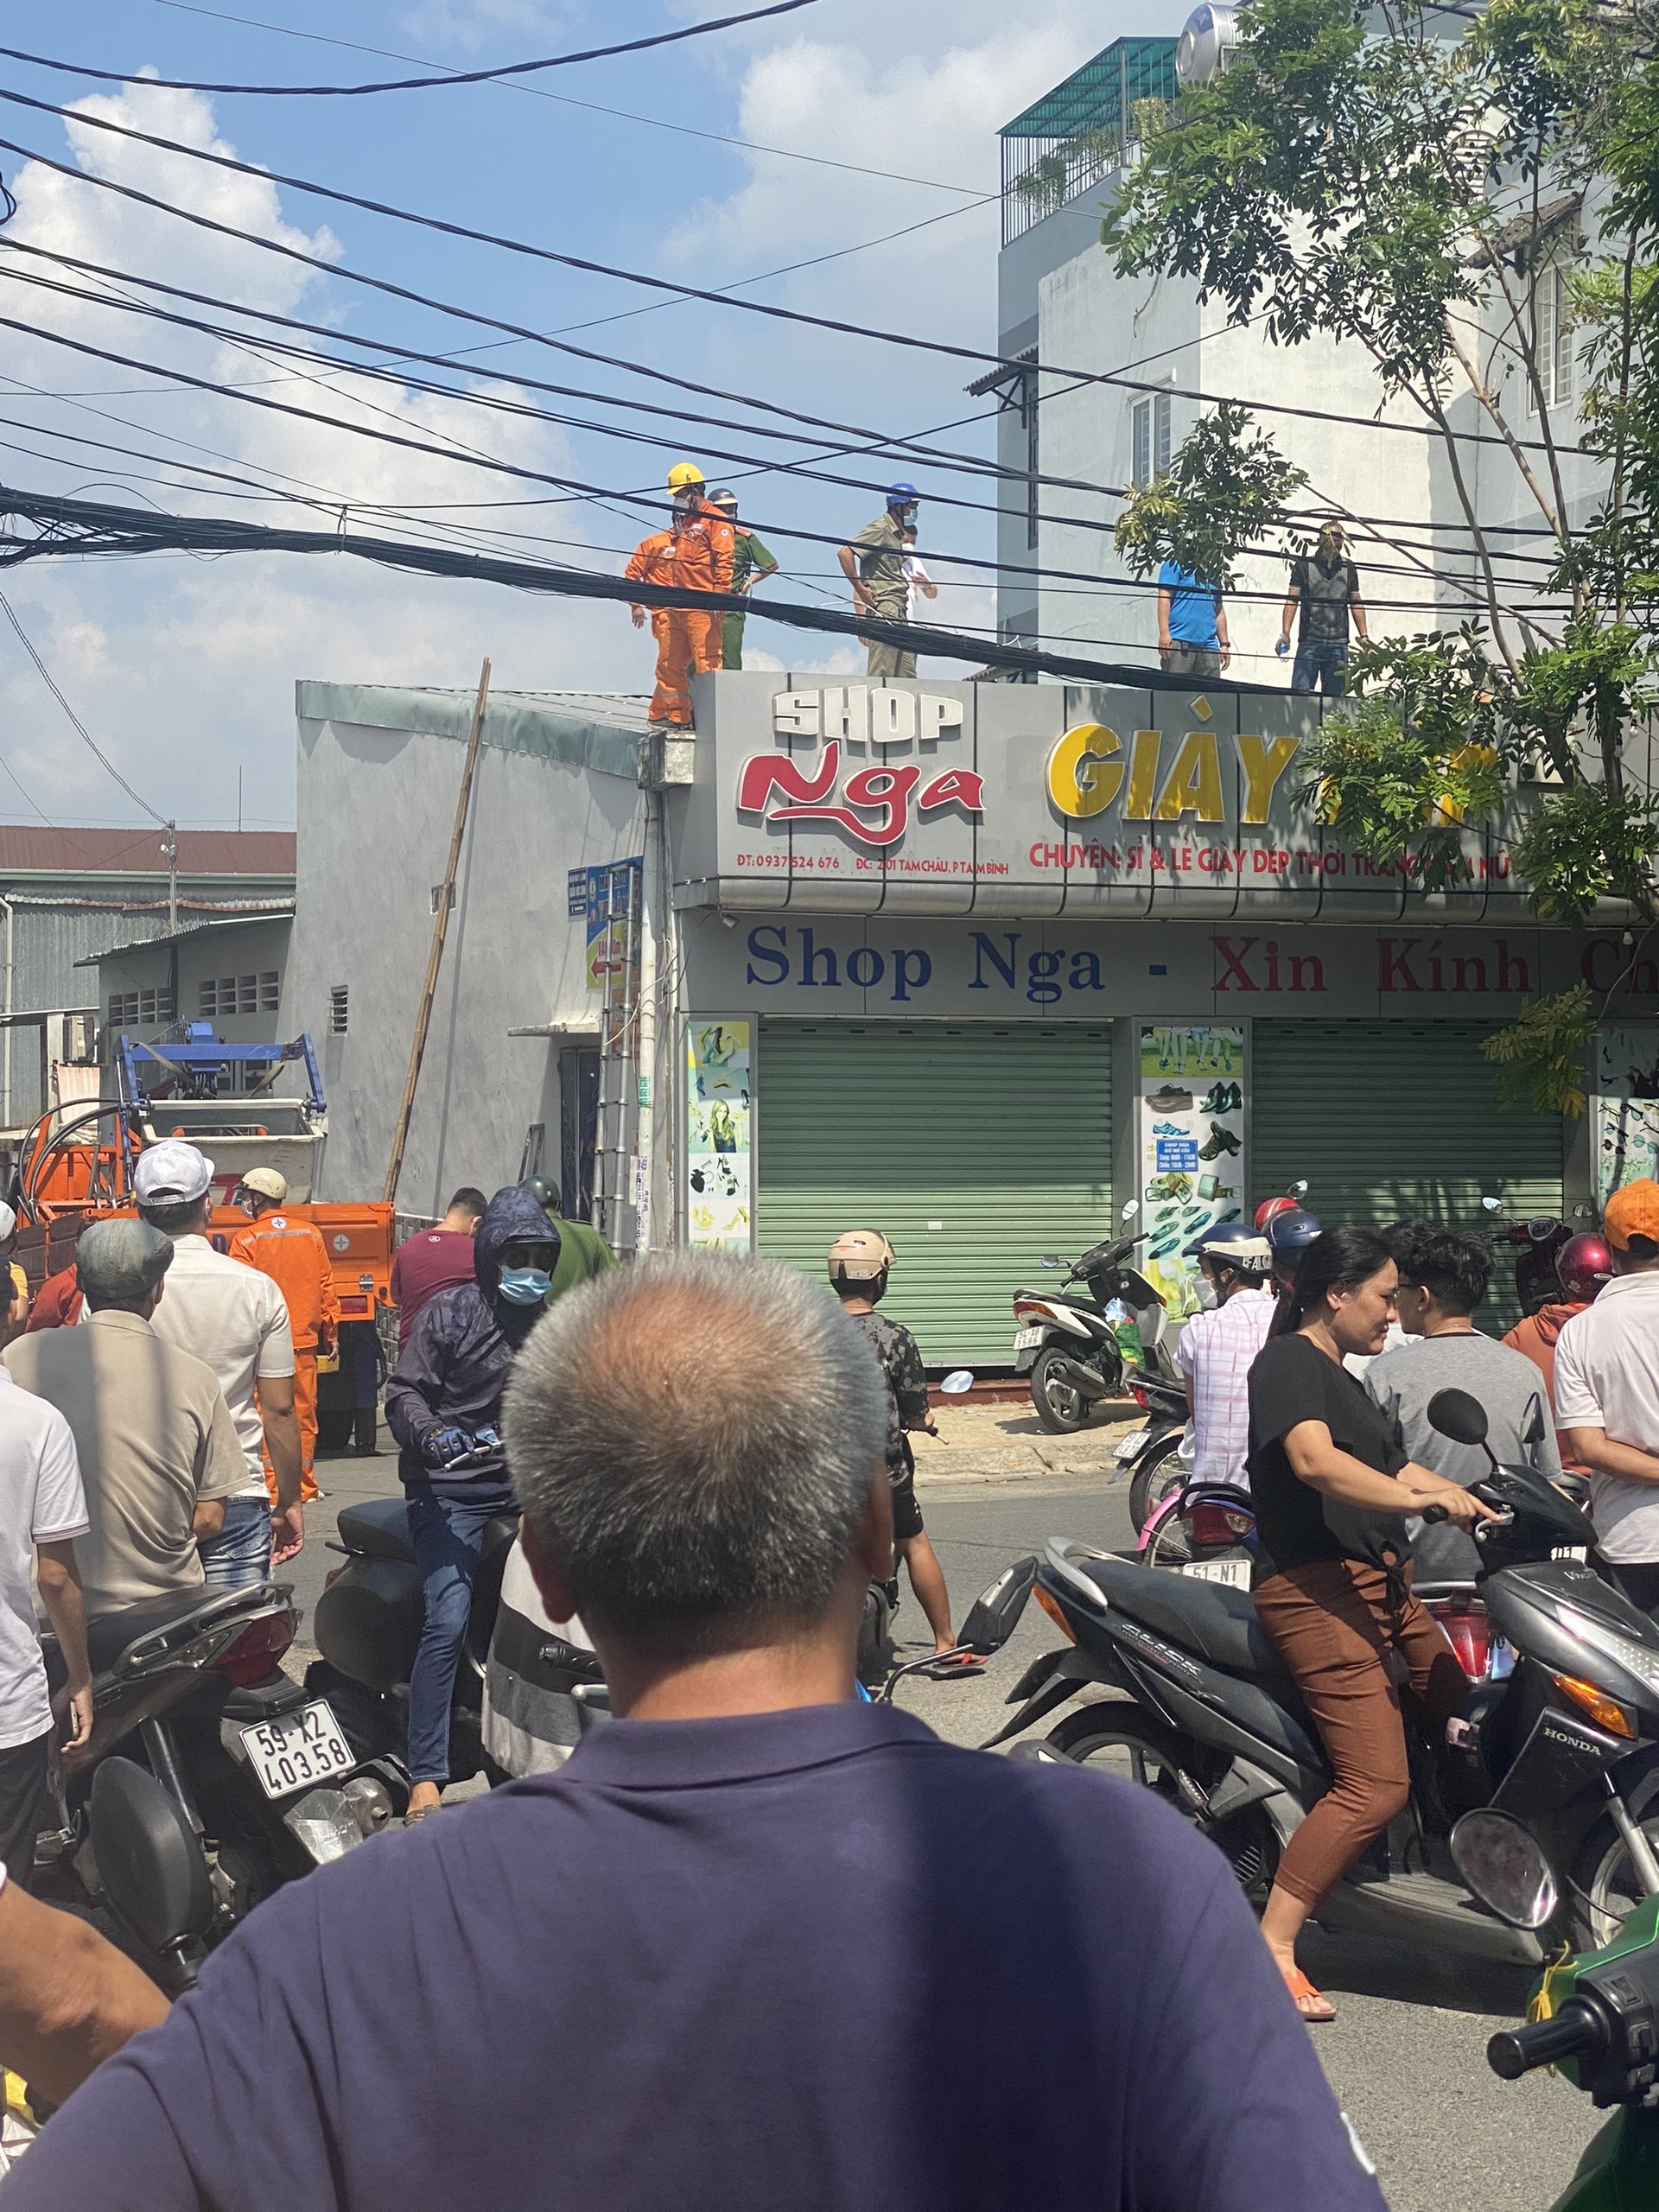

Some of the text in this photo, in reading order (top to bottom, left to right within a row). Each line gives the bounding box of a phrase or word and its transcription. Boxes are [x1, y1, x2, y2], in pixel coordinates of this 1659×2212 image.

[774, 685, 963, 742] SHOP
[1048, 695, 1302, 825] GIÀY
[738, 740, 987, 846] Nga
[818, 856, 840, 869] 676
[1029, 837, 1122, 869] CHUYÊN:
[1149, 845, 1166, 871] &
[1198, 840, 1248, 874] GIÀY
[1253, 842, 1290, 874] DÉP
[1295, 844, 1346, 876] THỜI
[747, 925, 932, 1001] Shop
[968, 932, 1106, 1004] Nga
[1209, 936, 1328, 992] Xin
[1375, 938, 1533, 993] Kính
[264, 1738, 347, 1789] 403.58
[1544, 1727, 1601, 1757] HONDA
